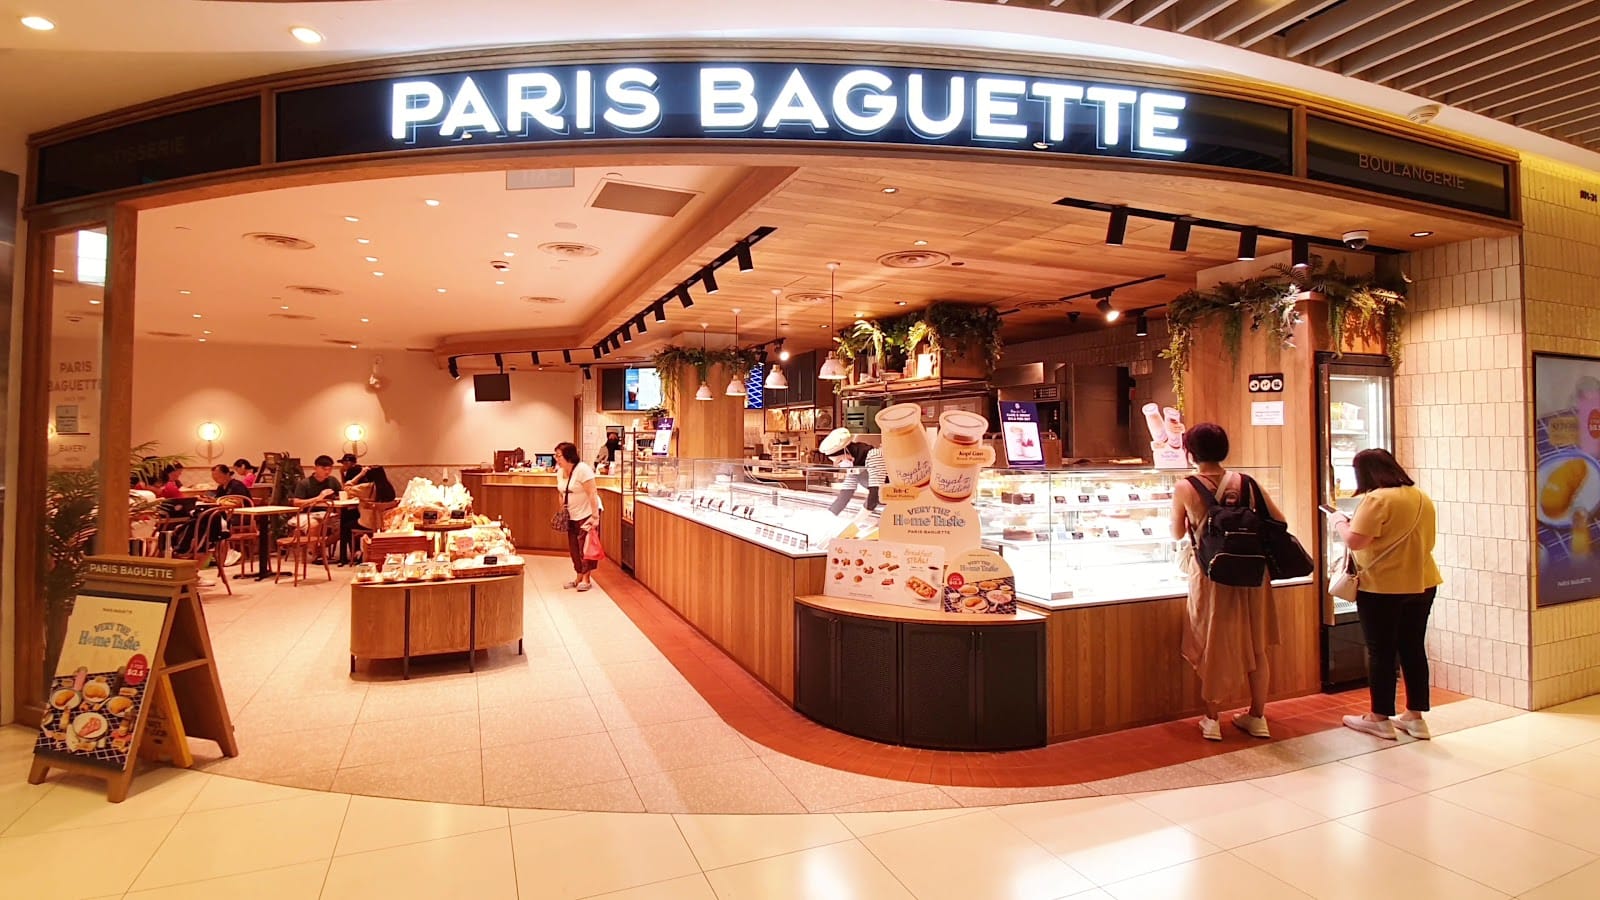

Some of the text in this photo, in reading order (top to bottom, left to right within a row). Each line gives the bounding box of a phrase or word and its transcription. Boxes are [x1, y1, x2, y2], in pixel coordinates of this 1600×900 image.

[391, 66, 1188, 154] PARIS BAGUETTE
[1358, 153, 1466, 190] BOULANGERIE
[59, 360, 92, 373] PARIS
[907, 505, 951, 517] VERY THE
[893, 514, 966, 528] Home Taste
[89, 563, 174, 579] PARIS BAGUETTE
[78, 630, 141, 651] Home Taste
